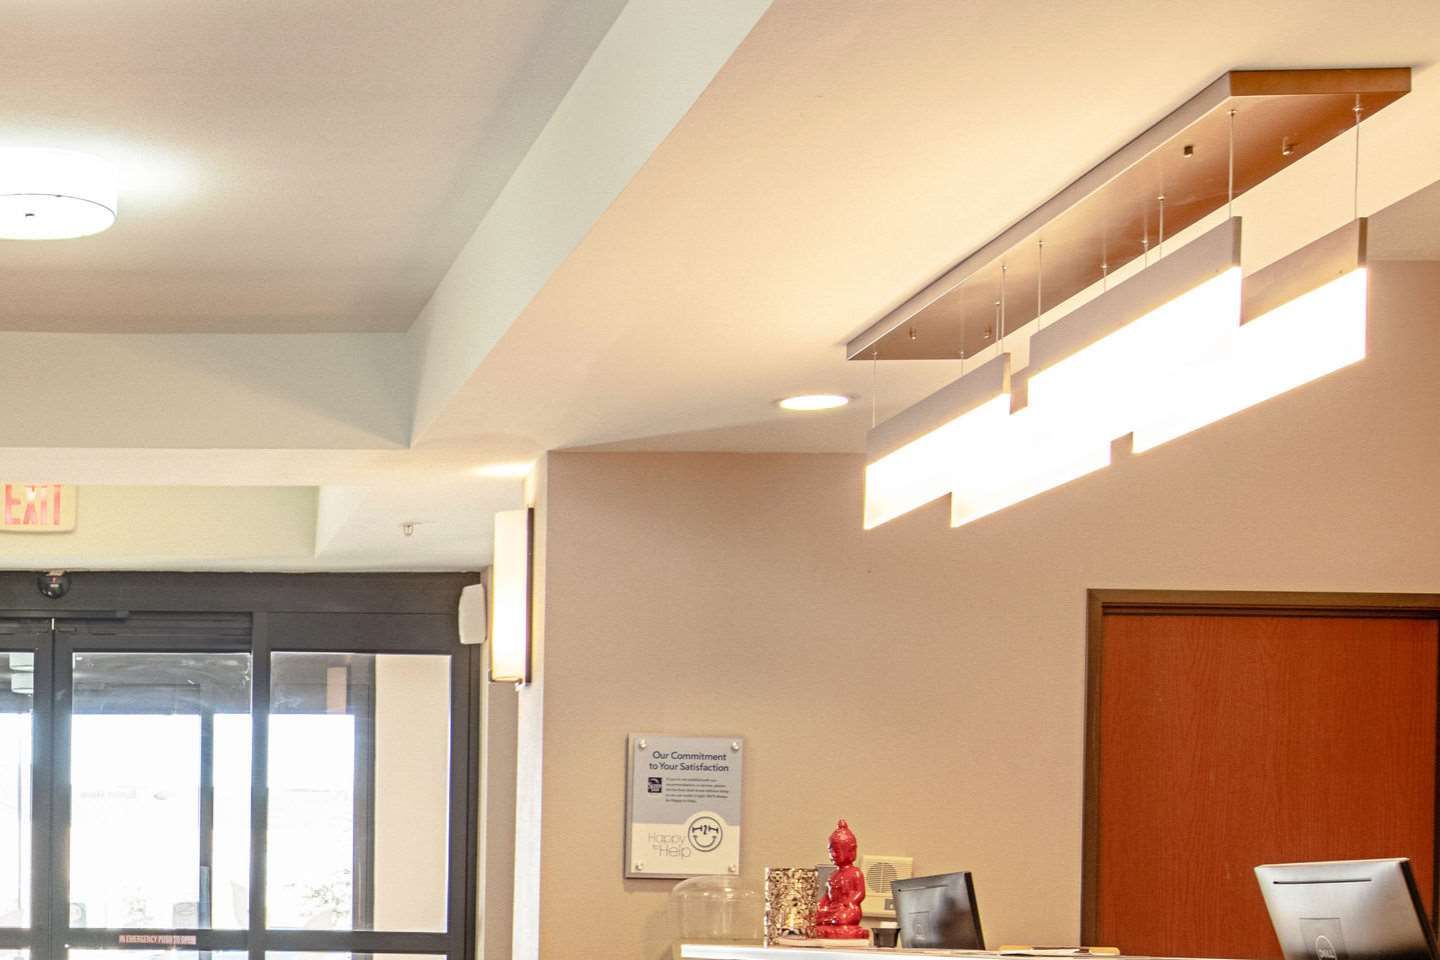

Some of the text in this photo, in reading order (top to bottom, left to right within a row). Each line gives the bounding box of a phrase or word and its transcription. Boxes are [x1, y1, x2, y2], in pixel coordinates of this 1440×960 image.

[4, 483, 62, 525] EXIT
[652, 750, 727, 761] Our Commitment
[649, 762, 729, 772] to Your Satisfaction
[659, 845, 691, 860] Help
